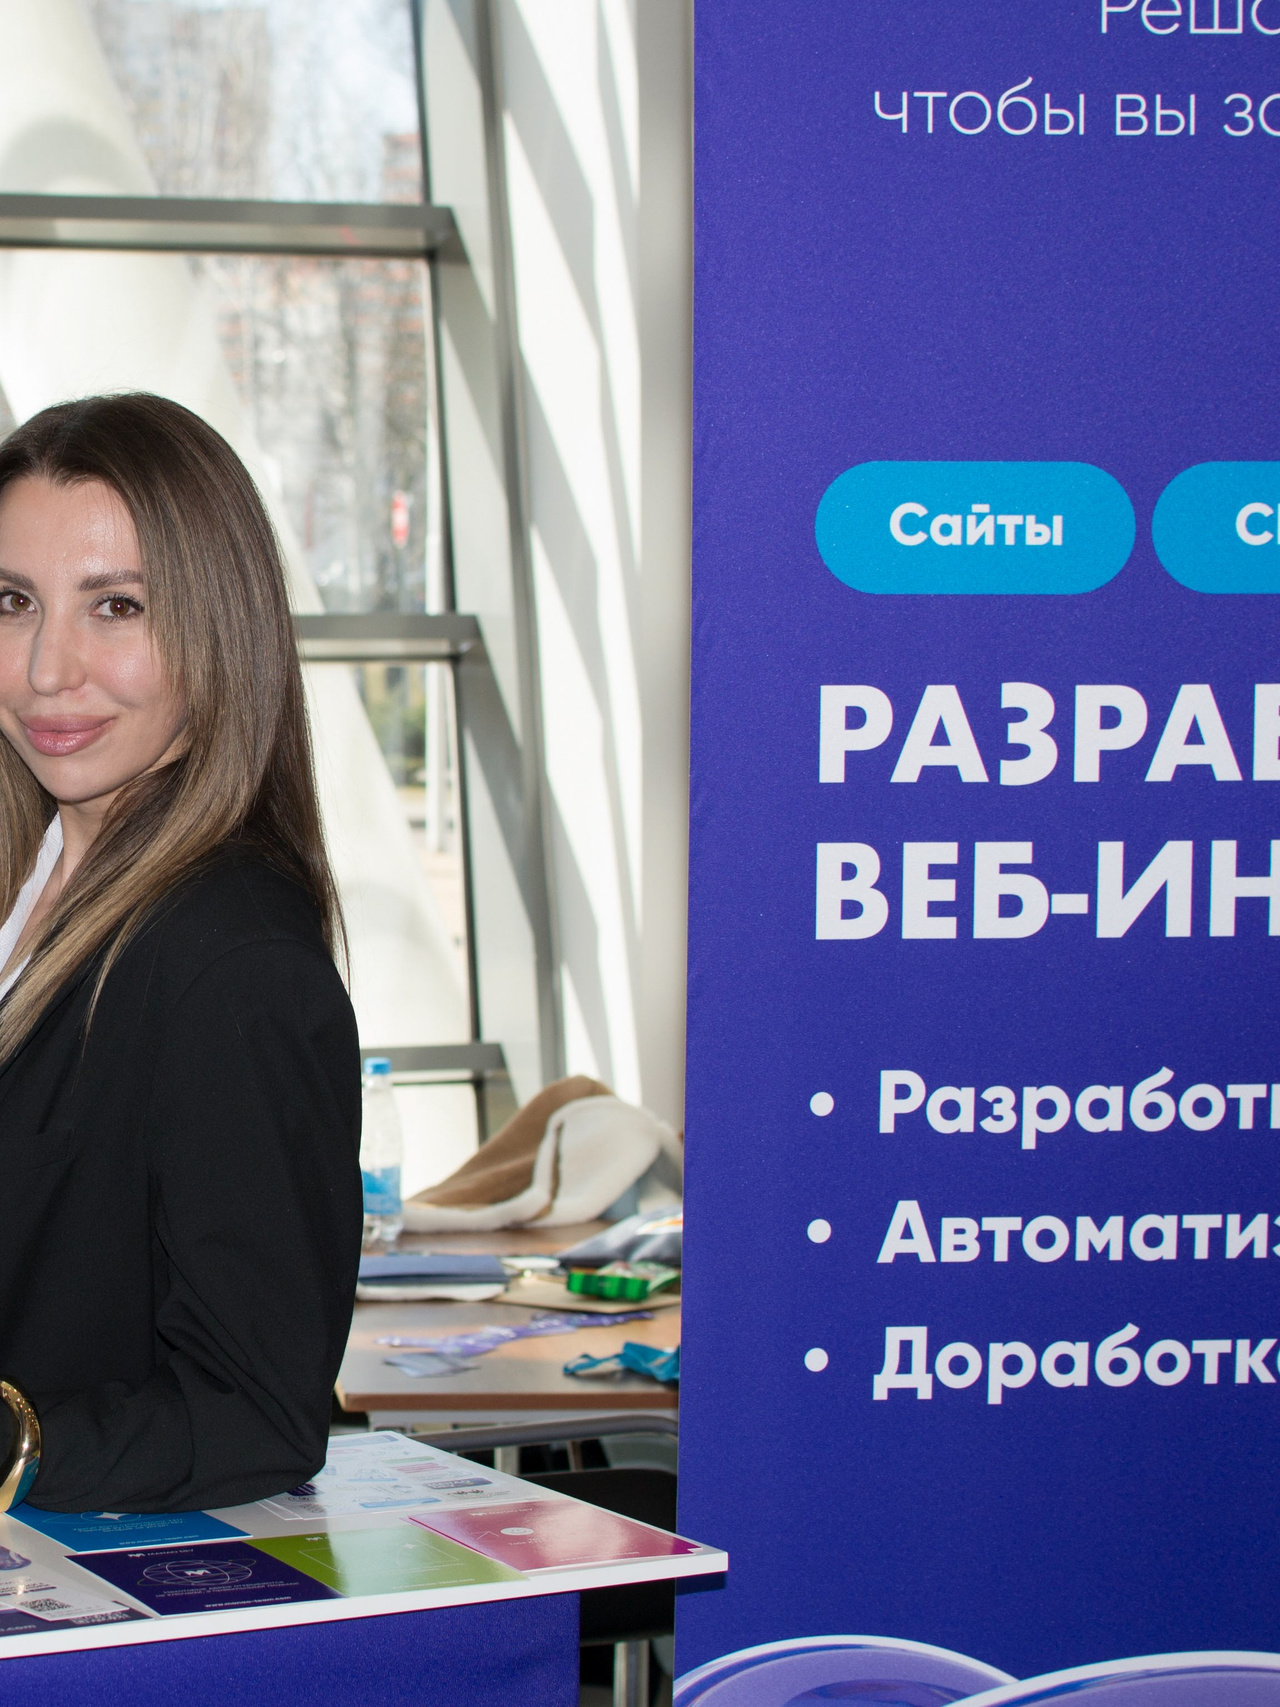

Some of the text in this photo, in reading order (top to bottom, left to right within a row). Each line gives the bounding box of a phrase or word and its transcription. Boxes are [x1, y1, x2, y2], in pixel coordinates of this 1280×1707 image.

[874, 76, 1085, 136] чтобы
[1116, 93, 1195, 136] вы
[889, 501, 1063, 546] Сайты
[816, 839, 1280, 940] ВЕБ-ИН
[878, 1066, 1280, 1150] Разработ
[877, 1200, 1280, 1263] Автомати
[873, 1322, 1280, 1405] Доработк
